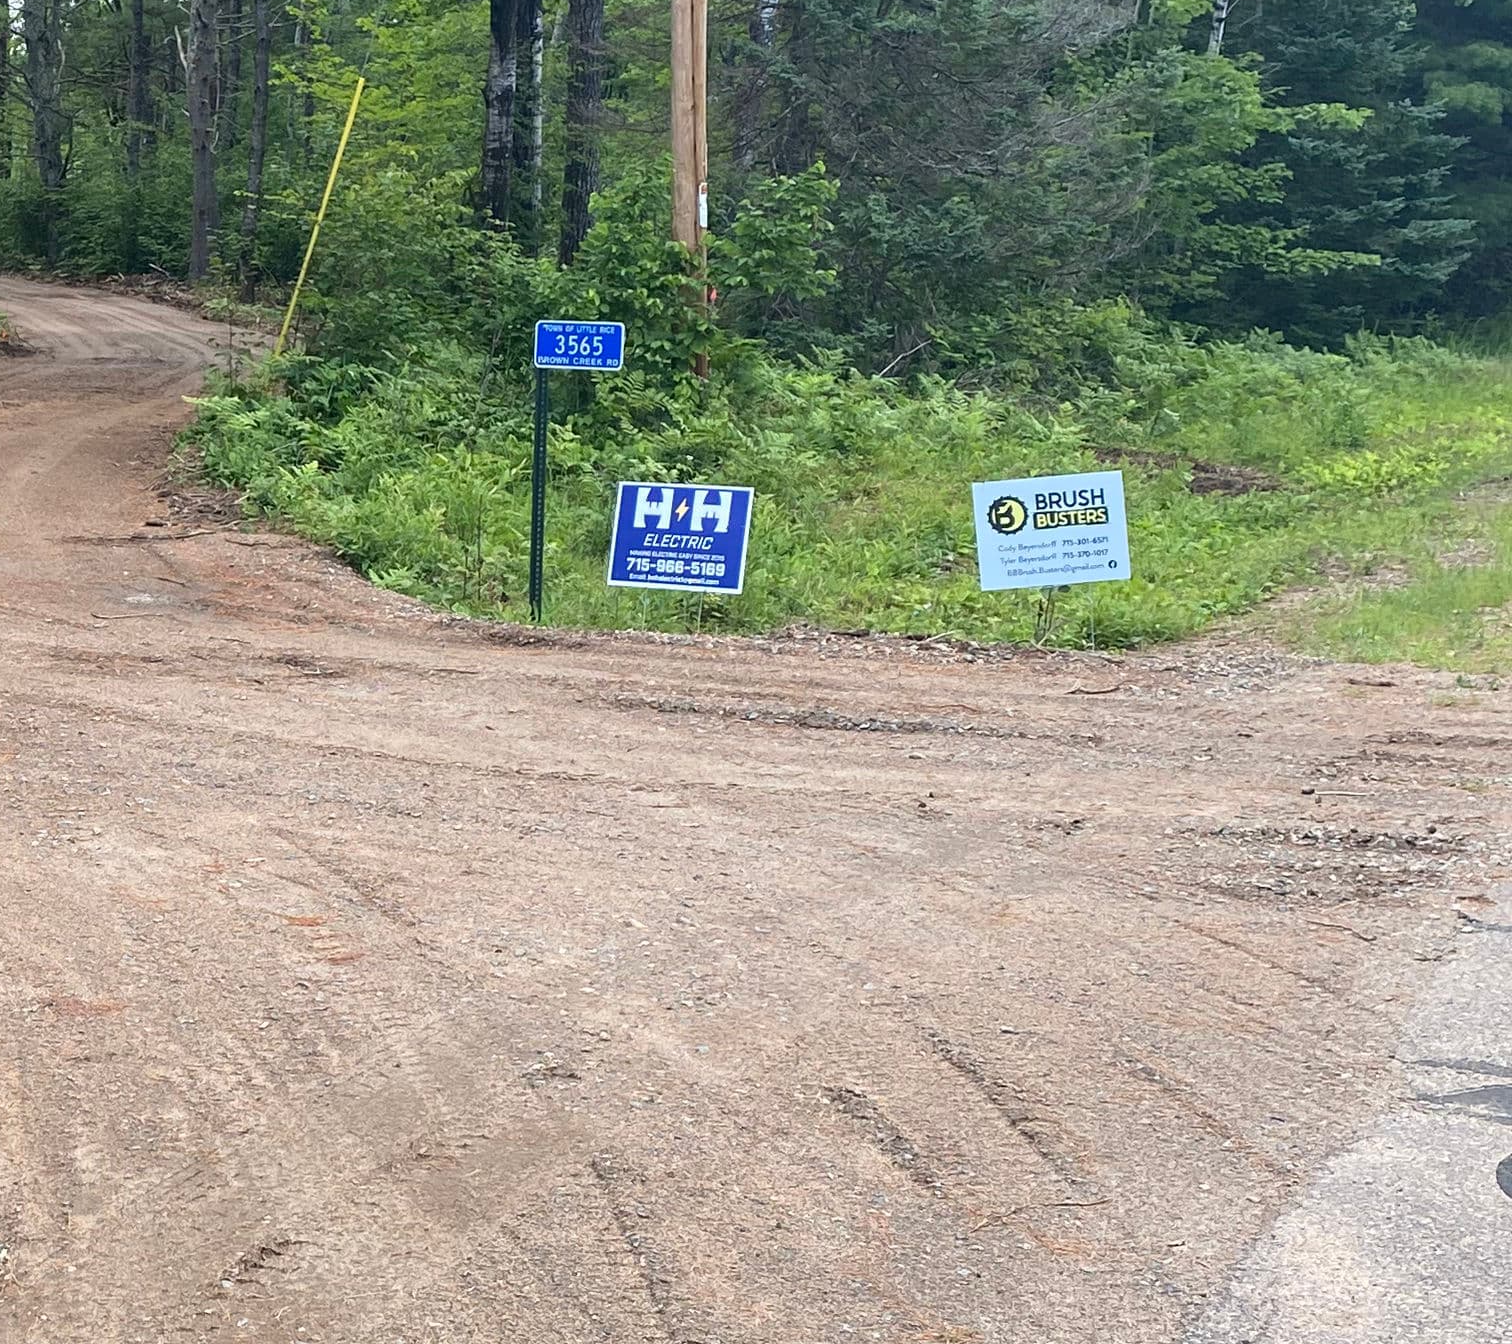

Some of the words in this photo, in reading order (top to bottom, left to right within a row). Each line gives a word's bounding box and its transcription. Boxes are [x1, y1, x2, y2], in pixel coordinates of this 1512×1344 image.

[542, 324, 563, 333] TOWN
[565, 325, 574, 333] OF
[576, 325, 597, 334] LITTLE
[599, 326, 615, 335] RICE
[555, 334, 603, 356] 3565
[537, 356, 569, 364] BROWN
[573, 357, 603, 366] CREEK
[606, 358, 619, 367] RD
[1034, 488, 1106, 510] BRUSH
[1036, 508, 1107, 528] BUSTERS
[643, 533, 714, 550] ELECTRIC
